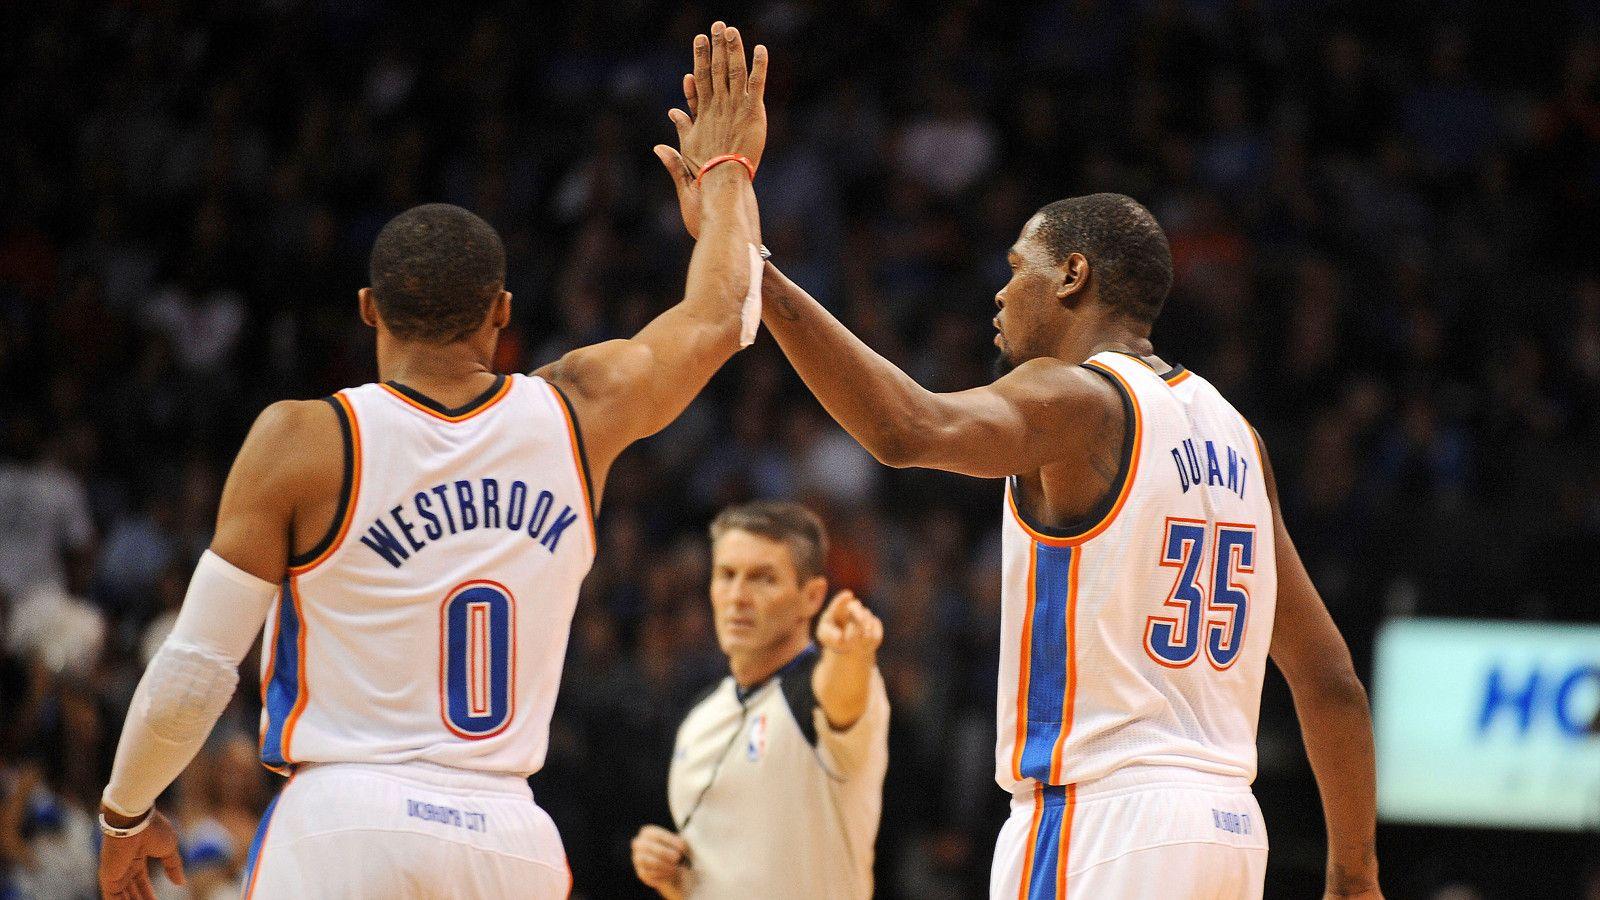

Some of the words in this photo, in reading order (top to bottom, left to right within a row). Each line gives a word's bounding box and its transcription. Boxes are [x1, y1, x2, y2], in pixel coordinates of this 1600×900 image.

[360, 478, 577, 568] WESTBROOK
[1171, 438, 1248, 499] DUANT
[1143, 516, 1256, 671] 35
[439, 579, 516, 741] 0
